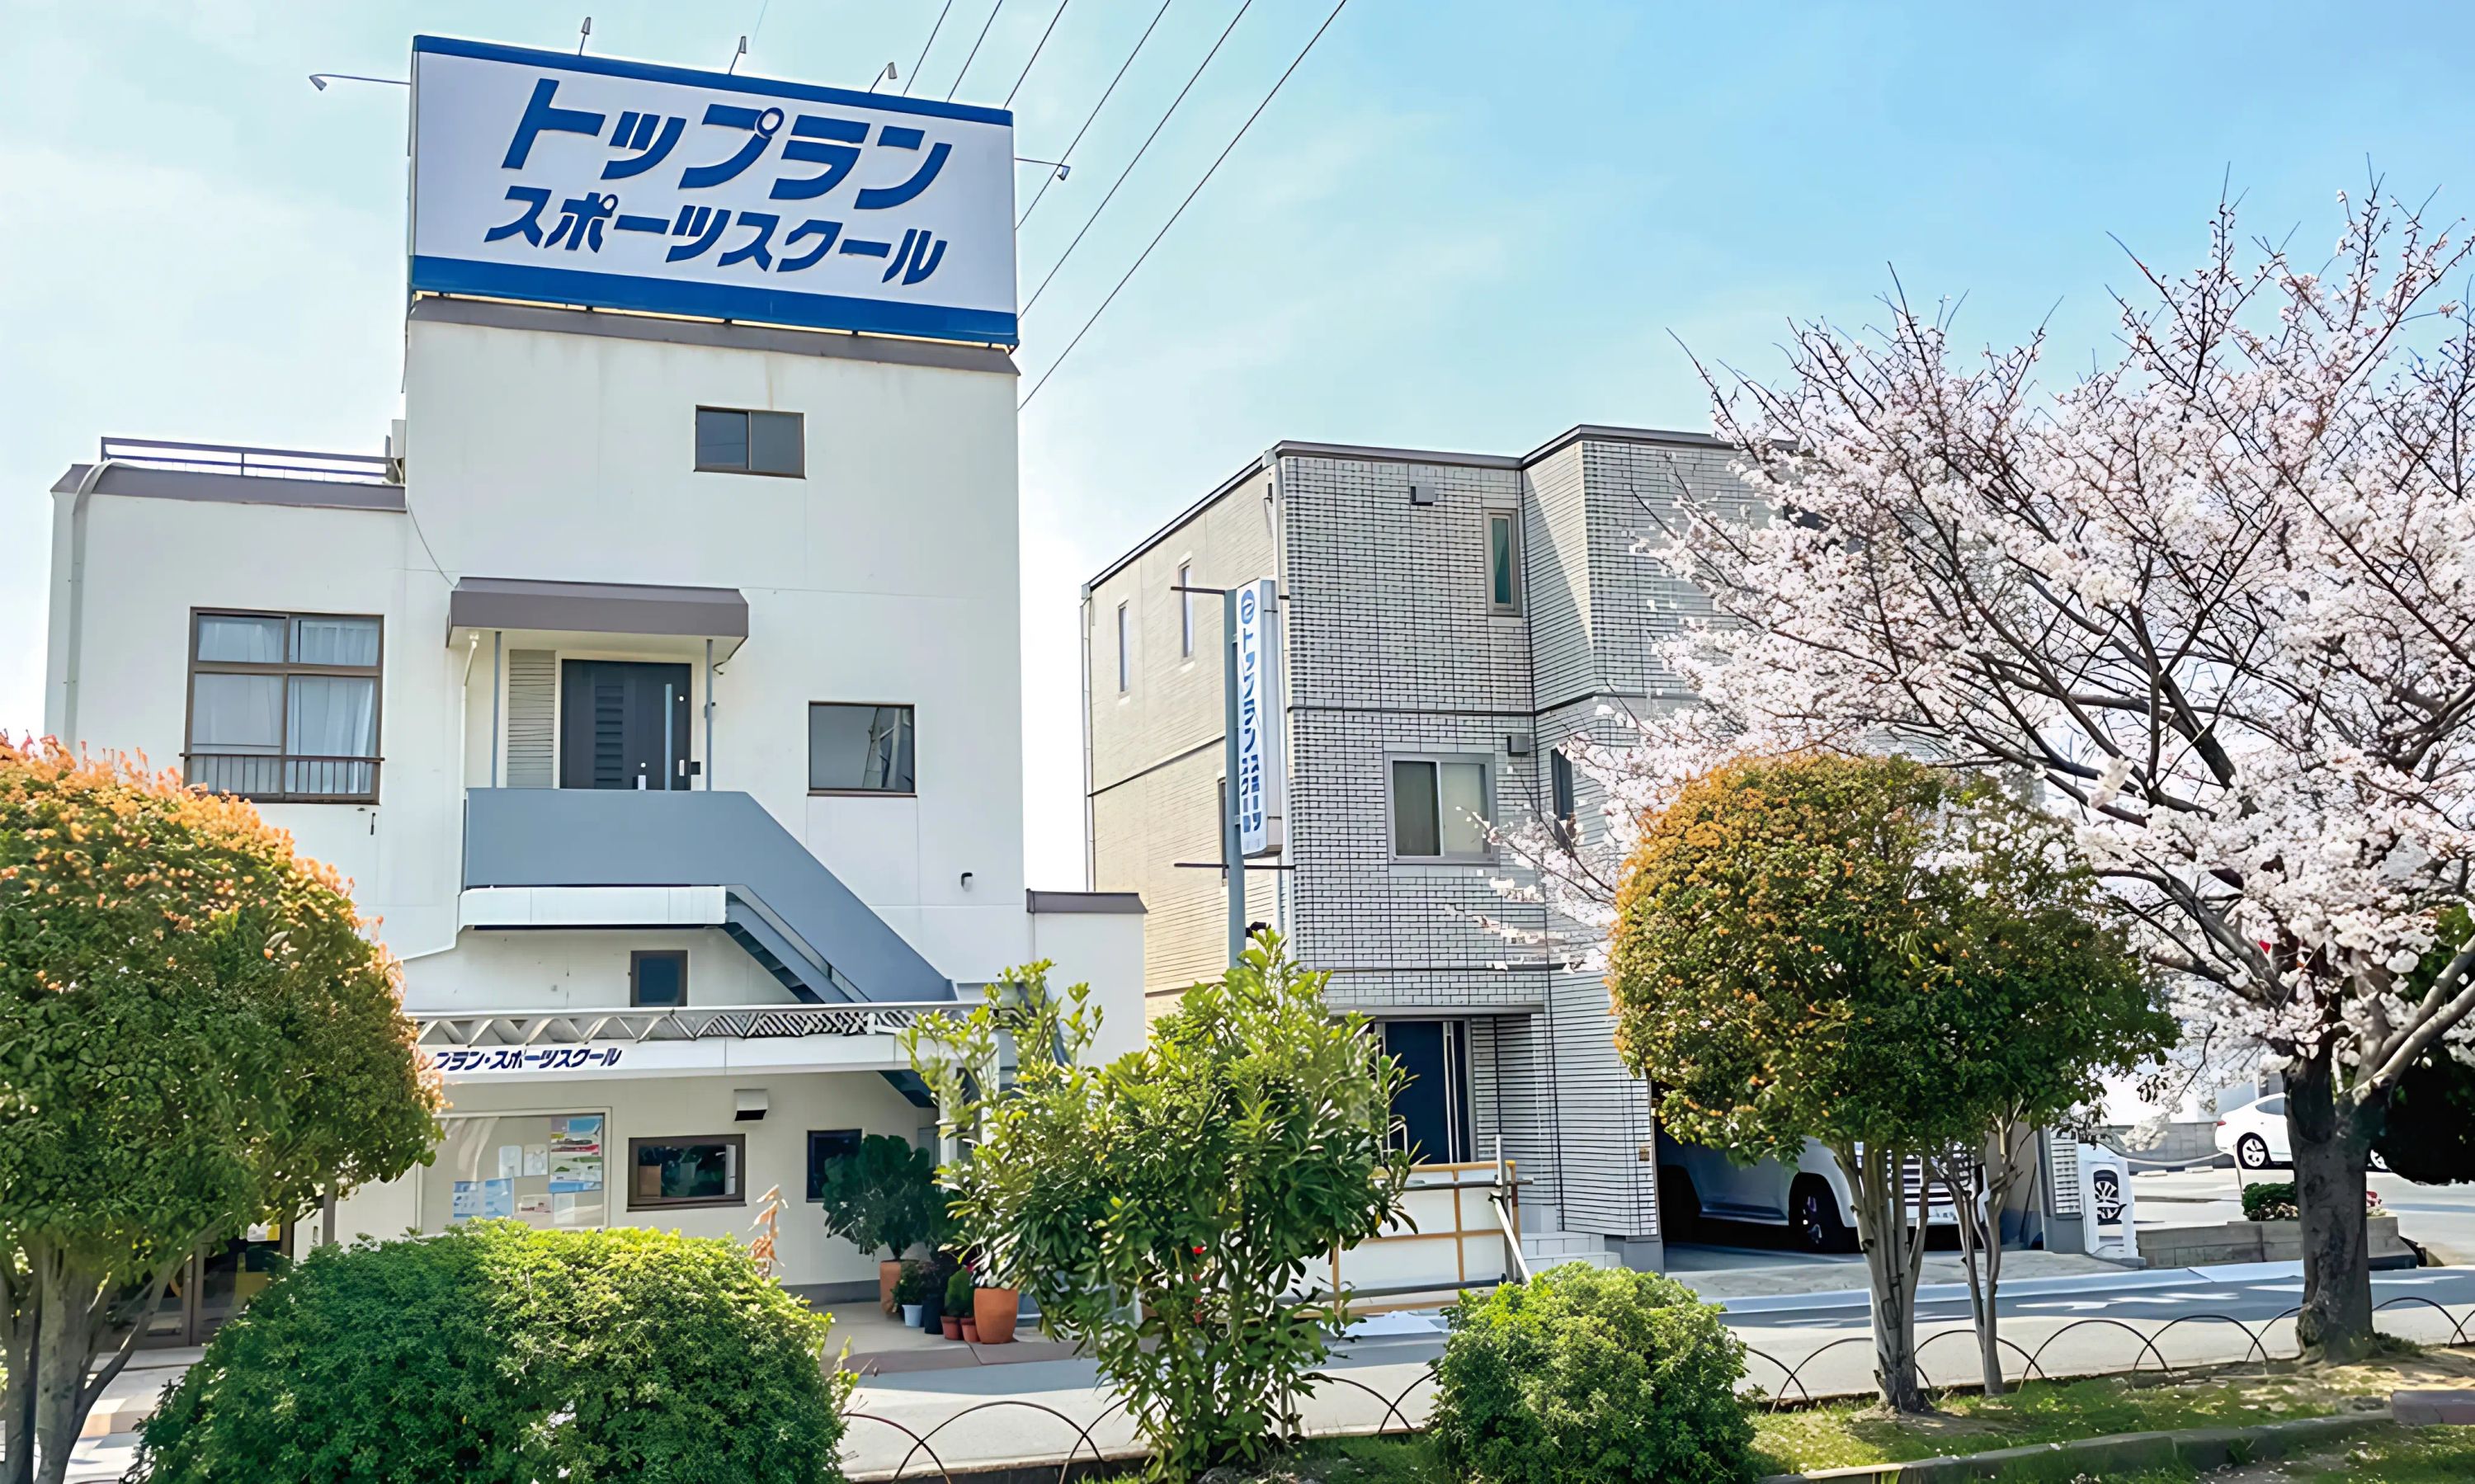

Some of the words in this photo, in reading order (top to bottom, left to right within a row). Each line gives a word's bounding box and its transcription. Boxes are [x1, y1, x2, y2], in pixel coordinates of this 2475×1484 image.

[501, 78, 952, 210] トップラン
[483, 184, 948, 285] スポーツスクール
